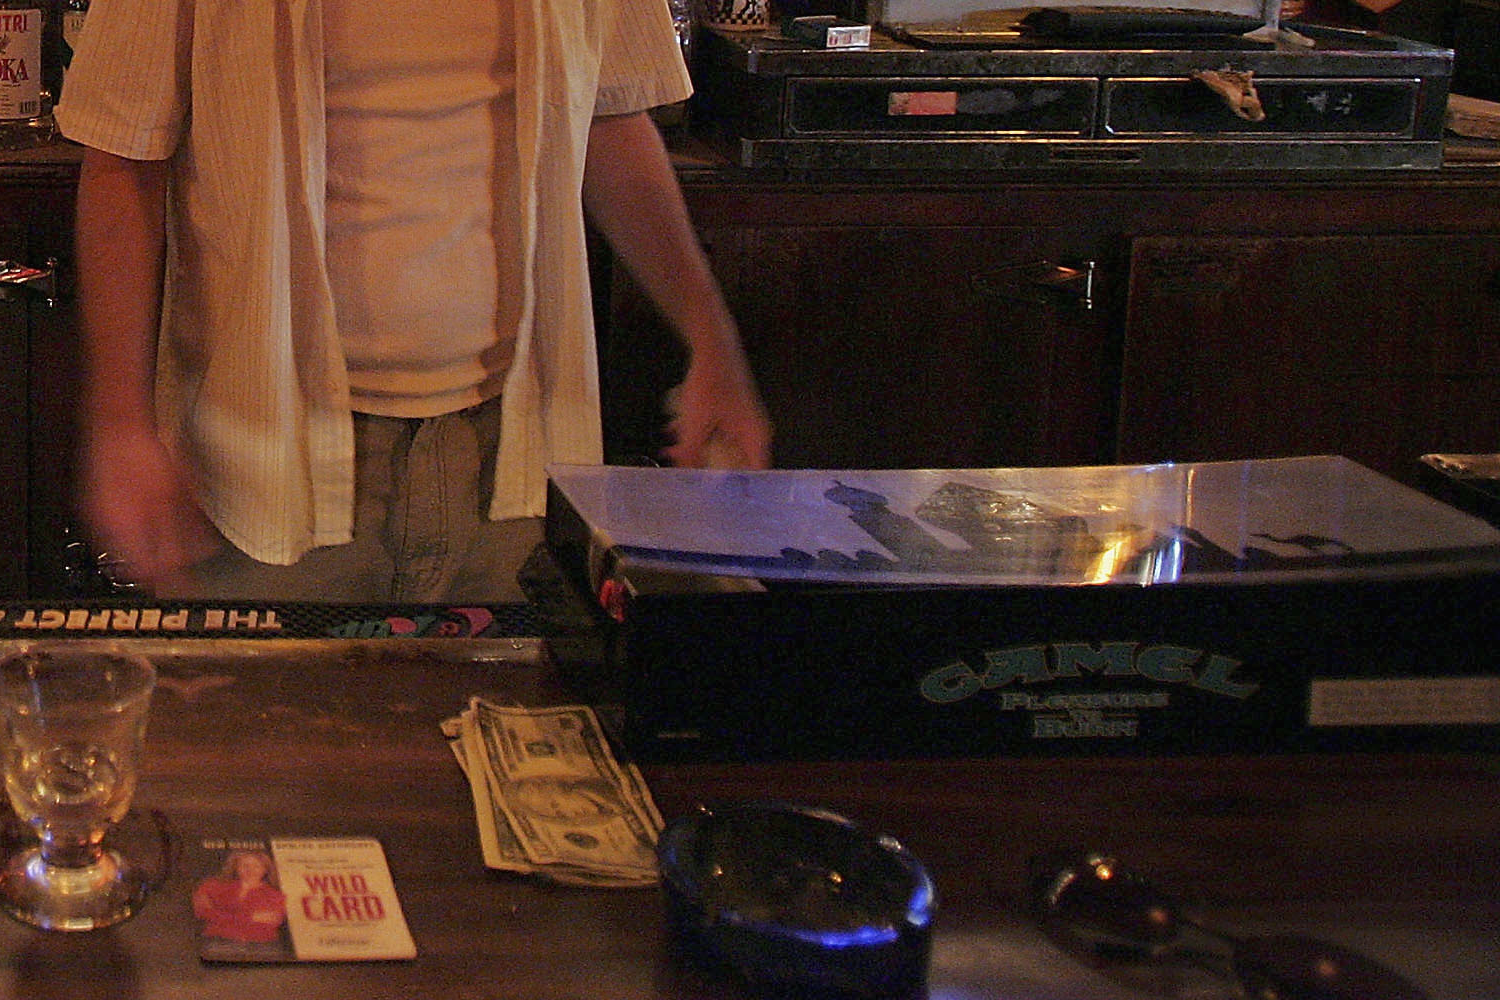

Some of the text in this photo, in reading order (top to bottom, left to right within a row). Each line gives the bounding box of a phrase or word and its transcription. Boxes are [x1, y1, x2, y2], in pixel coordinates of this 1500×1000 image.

[12, 606, 190, 632] PERFECT
[202, 608, 283, 631] THE
[919, 641, 1260, 704] CAMEL
[304, 873, 369, 895] WILD
[301, 895, 386, 922] CARD
